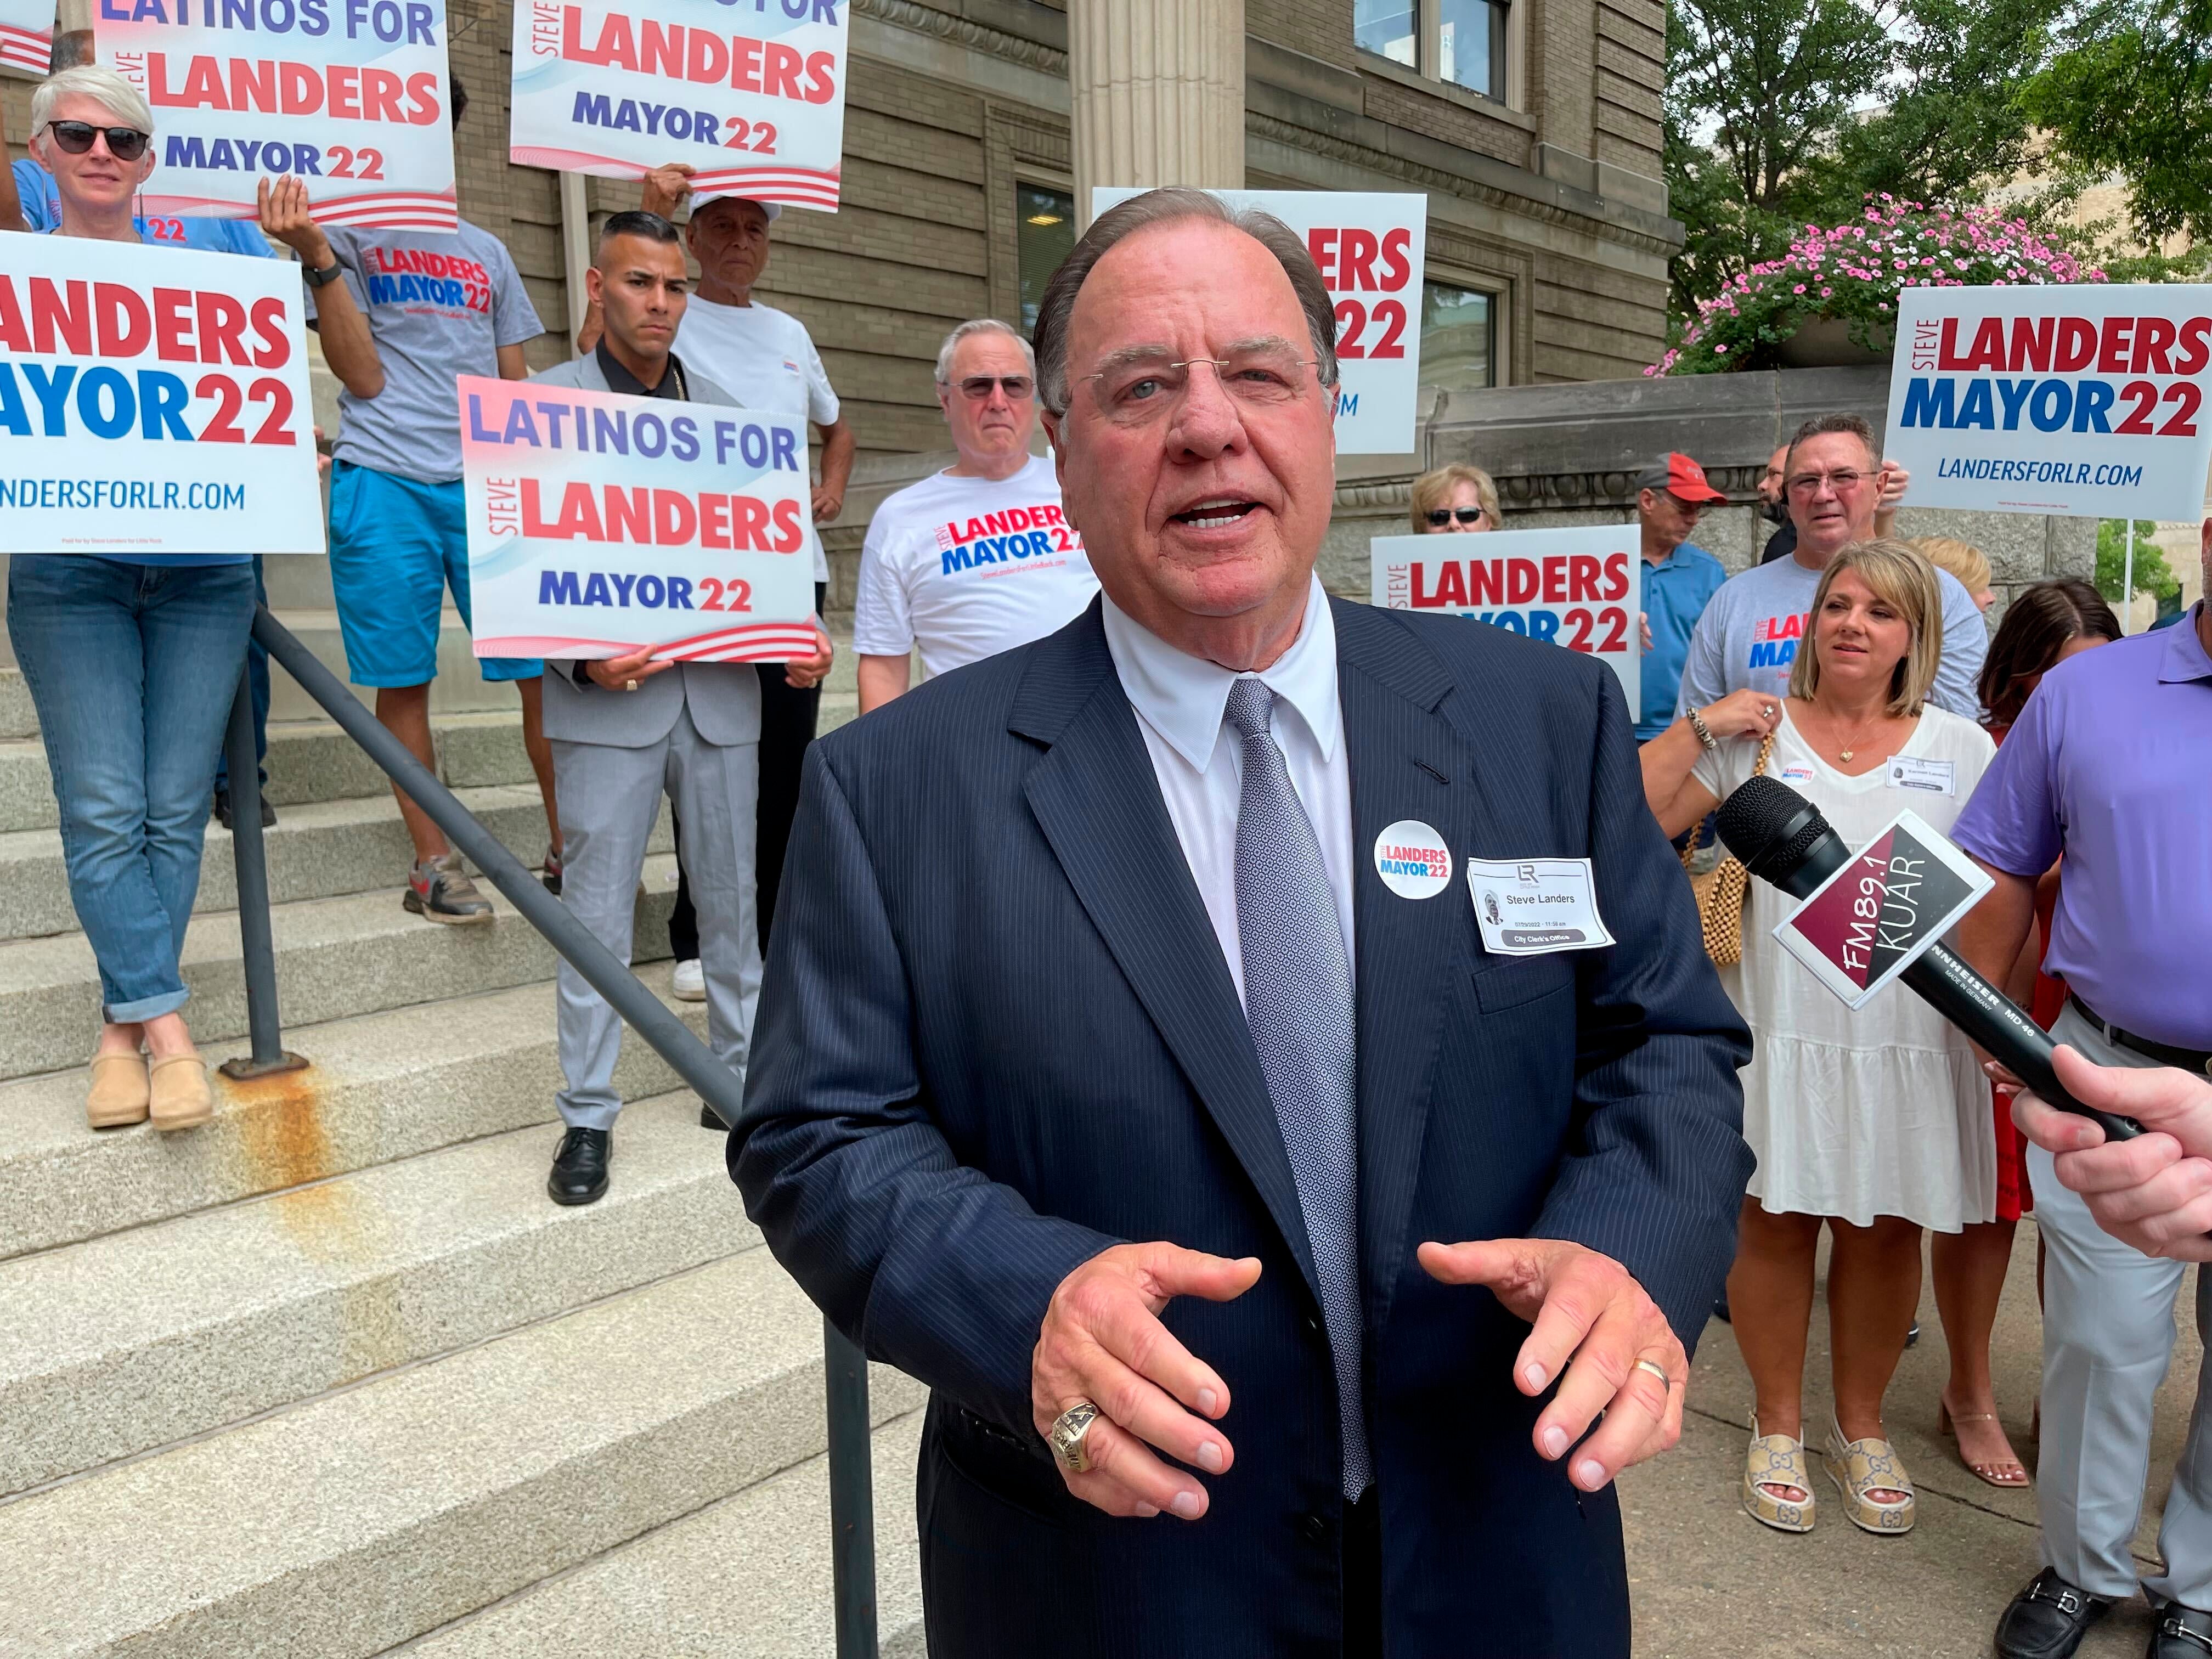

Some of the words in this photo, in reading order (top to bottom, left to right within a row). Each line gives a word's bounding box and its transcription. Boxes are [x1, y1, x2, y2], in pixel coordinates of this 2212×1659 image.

[346, 0, 437, 47] FOR
[533, 1, 559, 58] STEVE
[562, 5, 836, 105] LANDERS
[146, 51, 441, 126] LANDERS
[148, 218, 187, 242] 22
[375, 246, 490, 286] LANDERS
[1912, 319, 1939, 371] STEVE
[1938, 317, 2212, 375] LANDERS
[469, 394, 701, 462] LATINOS
[715, 421, 799, 472] FOR
[1938, 458, 2143, 487] LANDERSFORLR.COM
[487, 477, 518, 537] STEVE
[520, 477, 803, 555] LANDERS
[934, 524, 953, 551] STEVE
[1388, 565, 1408, 608] STEVE
[1410, 552, 1629, 608] LANDERS
[1750, 640, 1800, 668] MA
[1386, 845, 1447, 864] LANDERS
[1506, 895, 1535, 904] Steve
[1538, 894, 1575, 903] Landers
[1876, 856, 1925, 952] KUAR
[1514, 935, 1526, 944] City
[1945, 969, 1960, 985] MADE
[1966, 988, 1993, 1011] GERMANY
[2004, 1009, 2022, 1025] MD
[2022, 1024, 2035, 1037] 46
